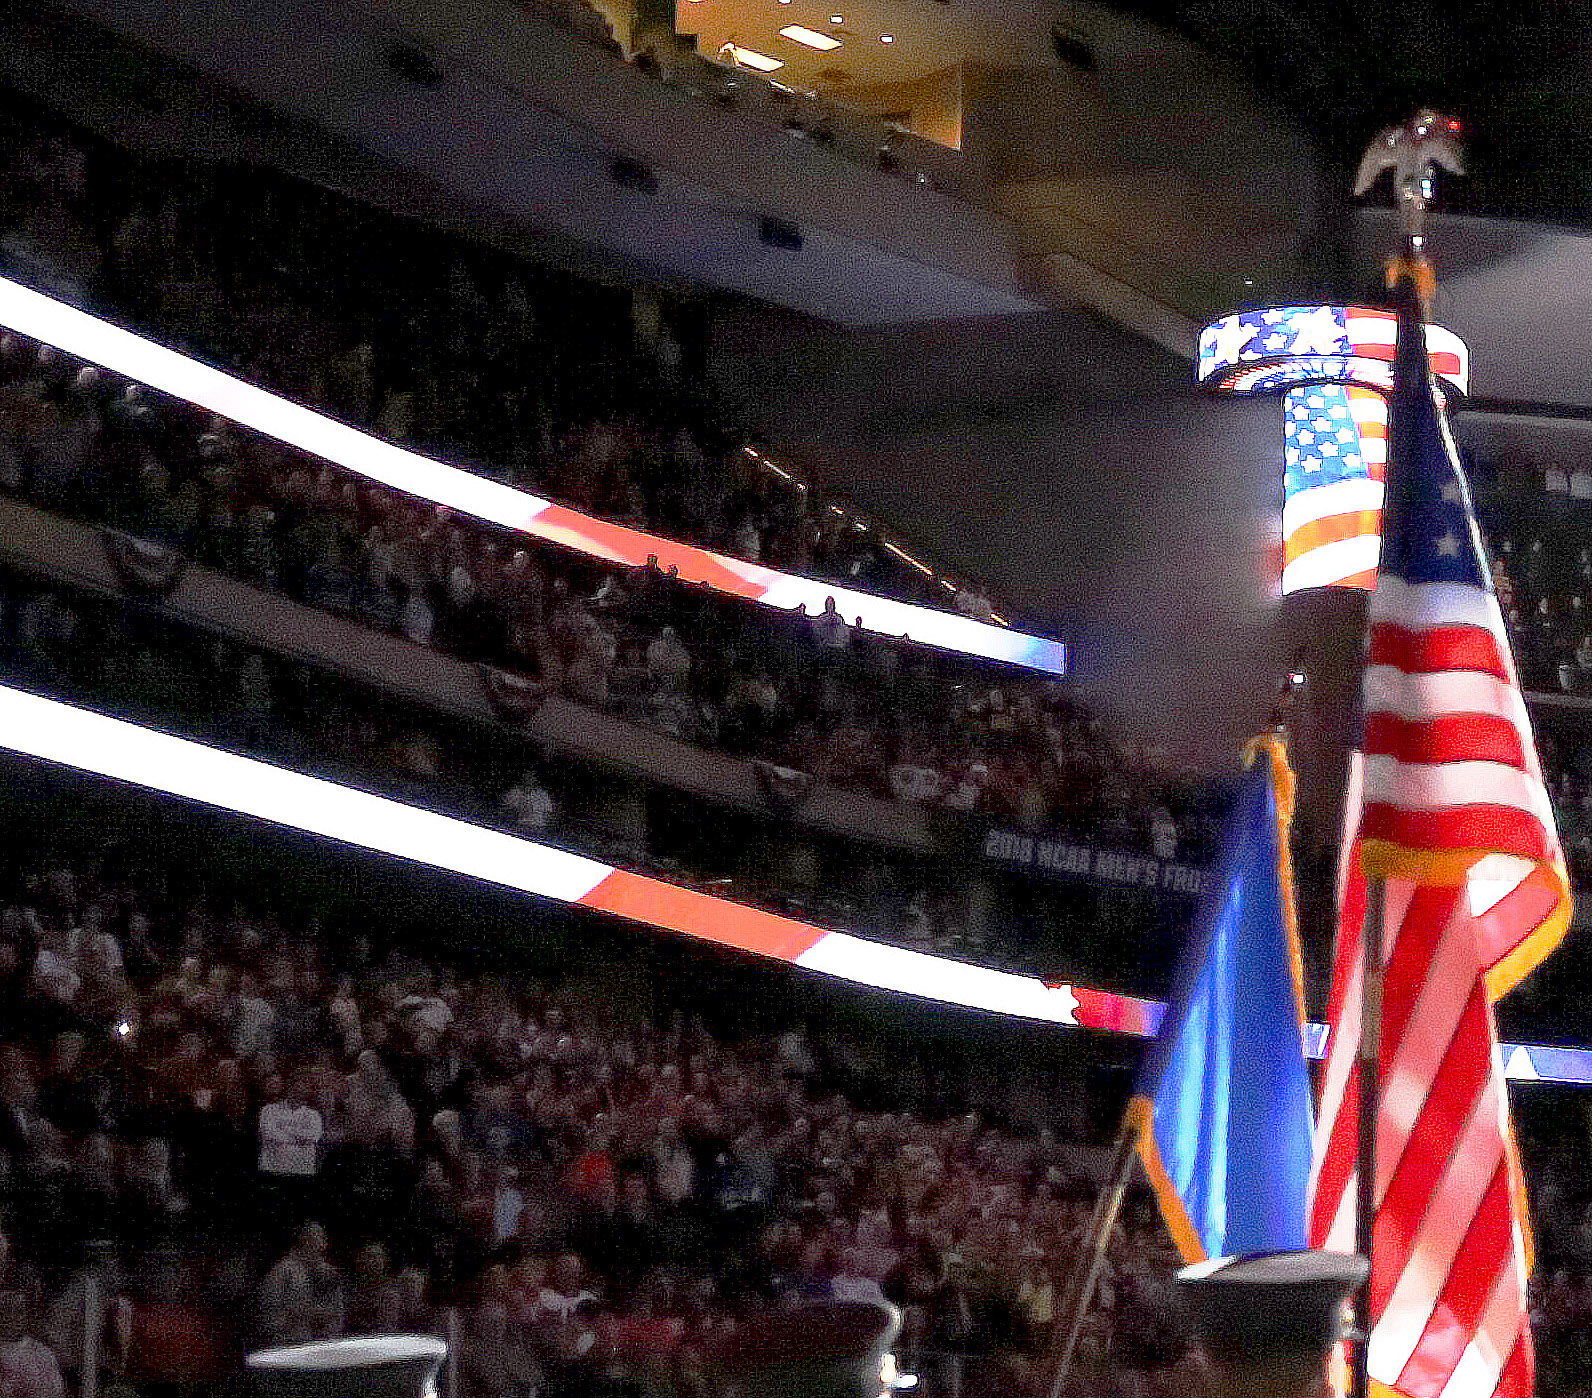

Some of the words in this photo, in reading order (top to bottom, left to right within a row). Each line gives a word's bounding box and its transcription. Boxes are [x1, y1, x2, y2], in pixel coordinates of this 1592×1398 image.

[985, 829, 1033, 863] 2018
[1037, 841, 1092, 875] NCAA
[1096, 852, 1160, 887] MEN'S
